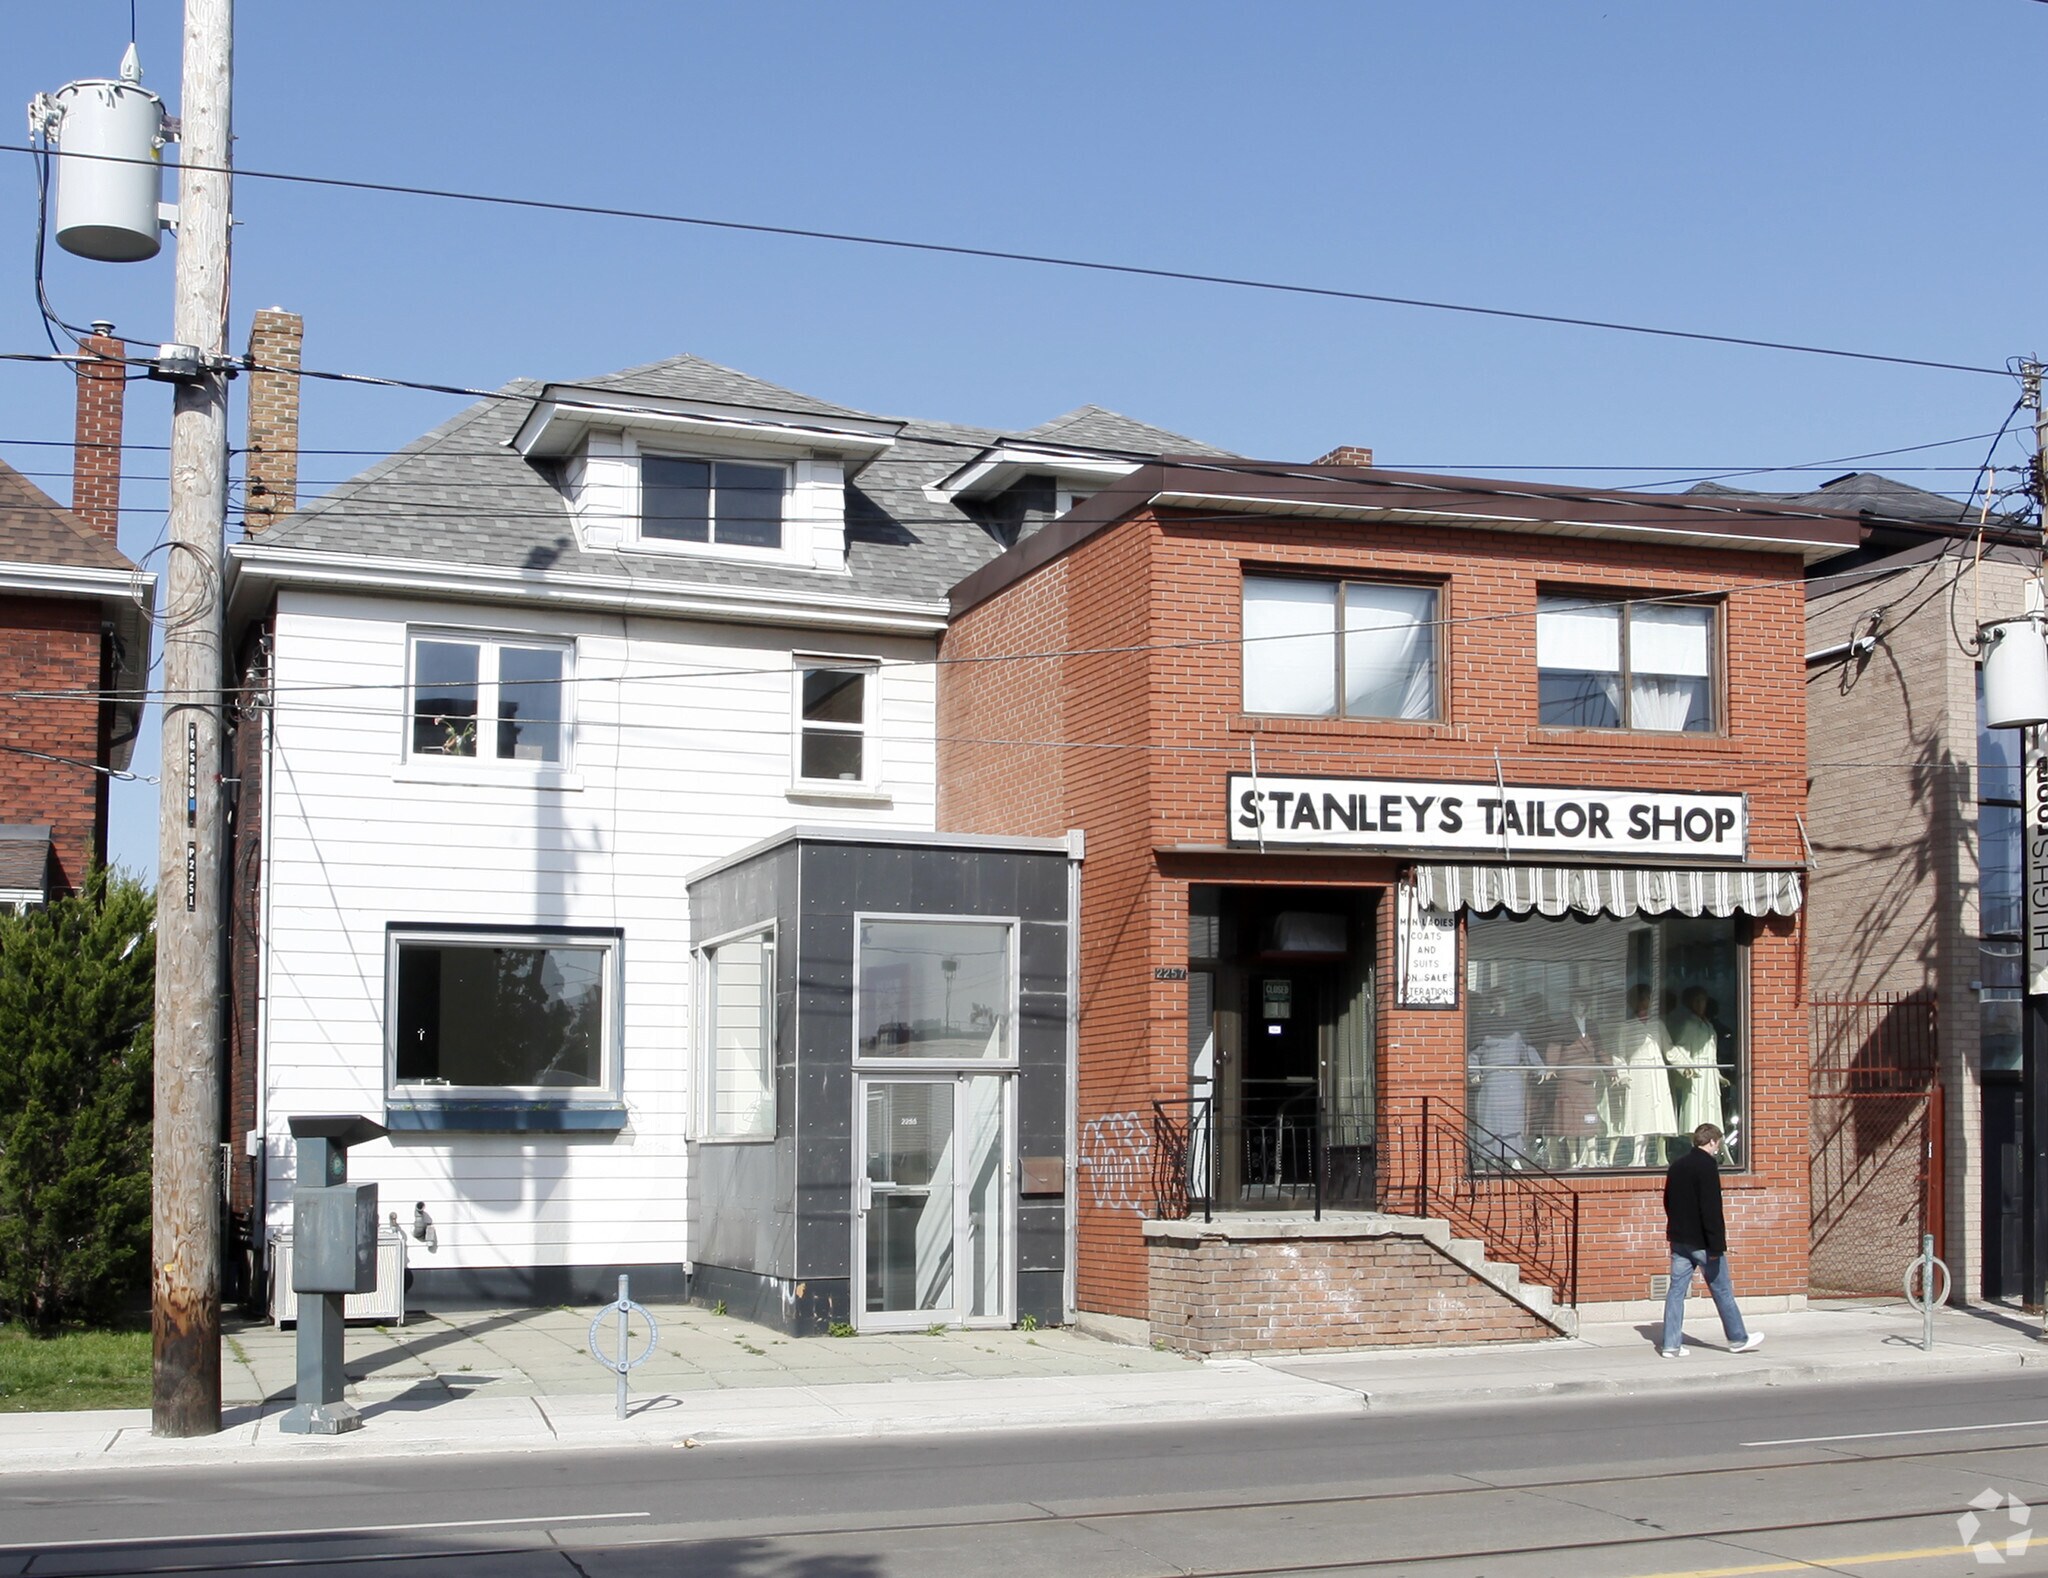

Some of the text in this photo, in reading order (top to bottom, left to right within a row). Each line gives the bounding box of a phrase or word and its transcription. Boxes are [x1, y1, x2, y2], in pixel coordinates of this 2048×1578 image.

[1238, 790, 1736, 842] STANLEY'S TAILOR SHOP
[188, 848, 196, 905] P2251
[1400, 918, 1418, 926] MN
[1411, 932, 1442, 941] COATS
[1417, 946, 1437, 954] AND
[1413, 960, 1439, 968] SUITS
[1156, 968, 1186, 979] 2257
[1424, 974, 1448, 982] SALE
[1400, 987, 1455, 996] ATERATIONS
